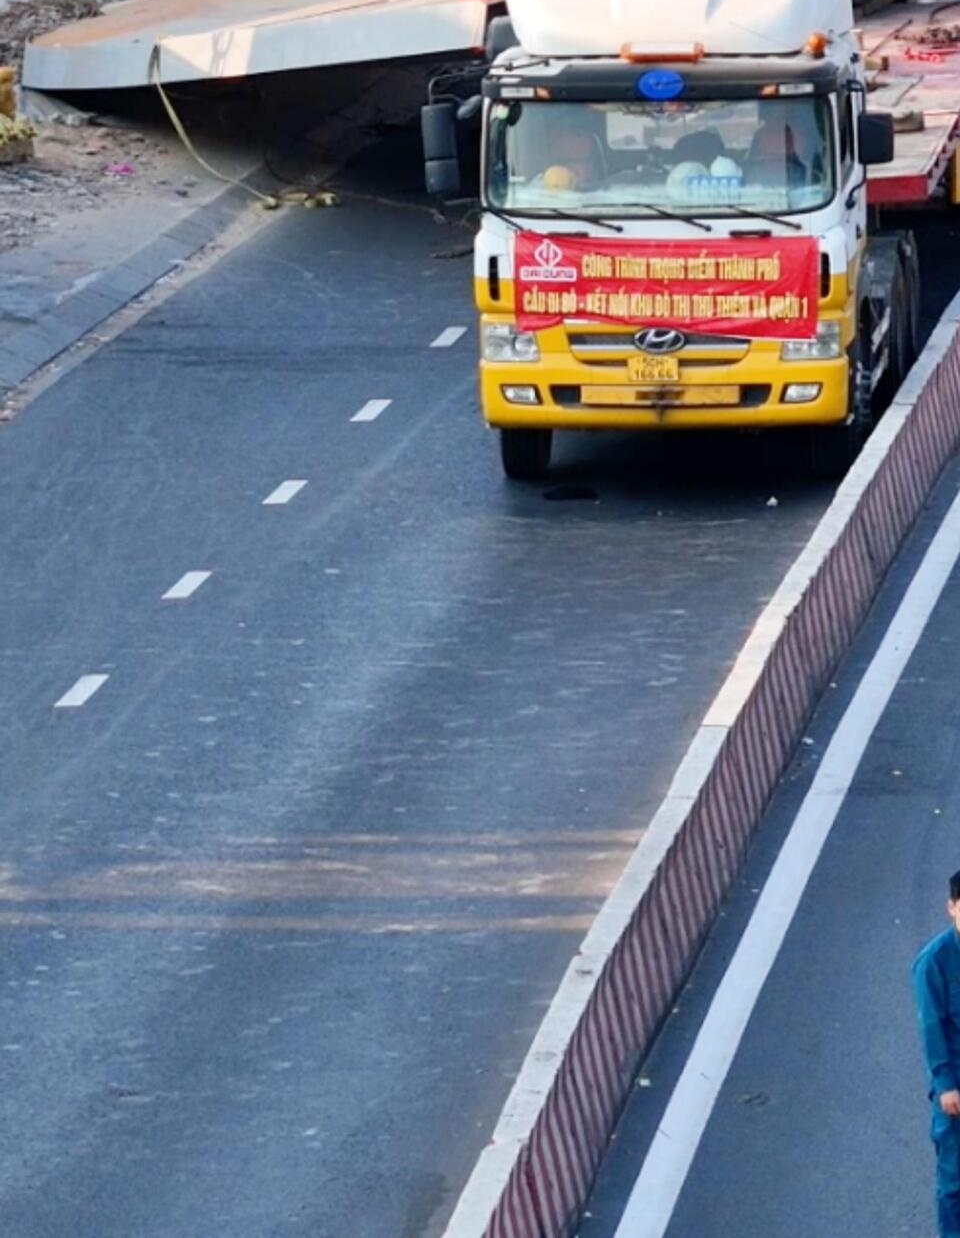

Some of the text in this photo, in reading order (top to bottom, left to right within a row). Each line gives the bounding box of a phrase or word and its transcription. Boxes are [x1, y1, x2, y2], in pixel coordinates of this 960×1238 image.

[582, 251, 613, 278] CÔNG
[718, 253, 755, 280] THÀNH
[757, 250, 780, 281] PHỐ
[586, 286, 607, 316] KẾT
[630, 292, 654, 317] KHU
[802, 296, 809, 318] 1
